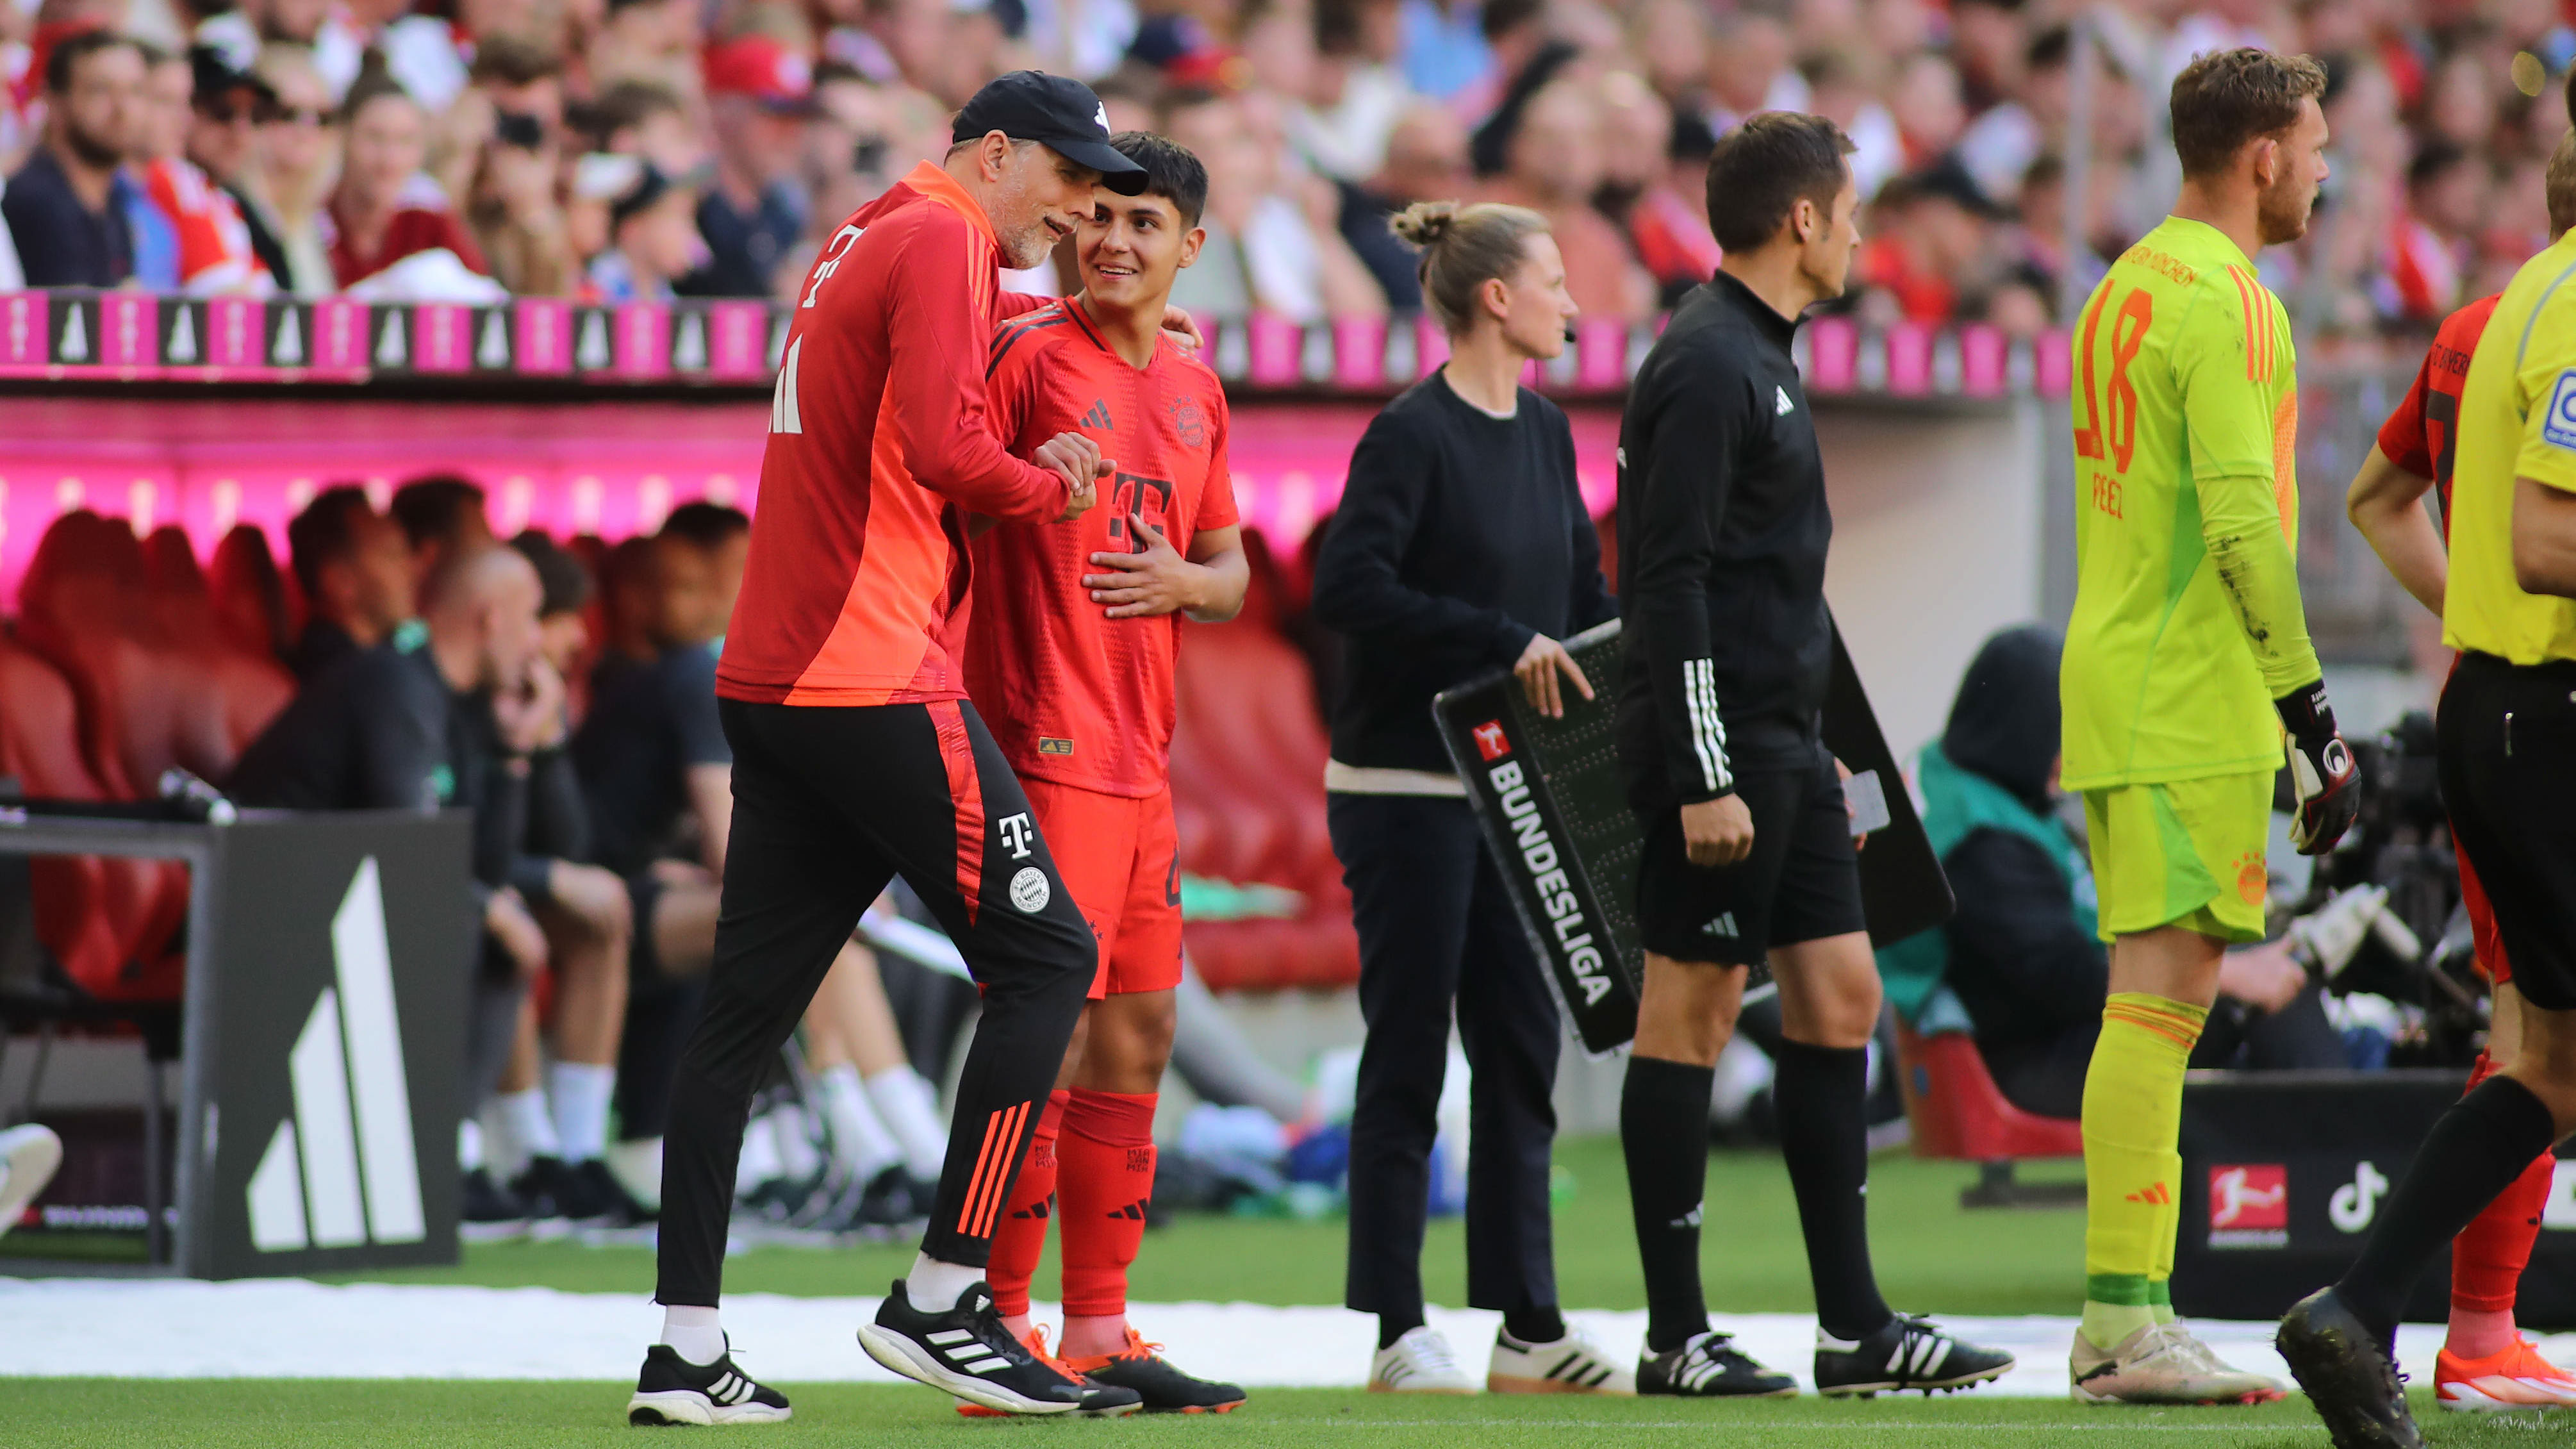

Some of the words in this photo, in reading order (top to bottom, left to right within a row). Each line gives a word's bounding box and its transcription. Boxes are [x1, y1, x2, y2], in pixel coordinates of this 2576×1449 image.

[2074, 279, 2152, 474] 18
[999, 812, 1033, 859] T
[1020, 871, 1044, 884] BAYERN
[1489, 760, 1613, 1007] BUNDESLIGA
